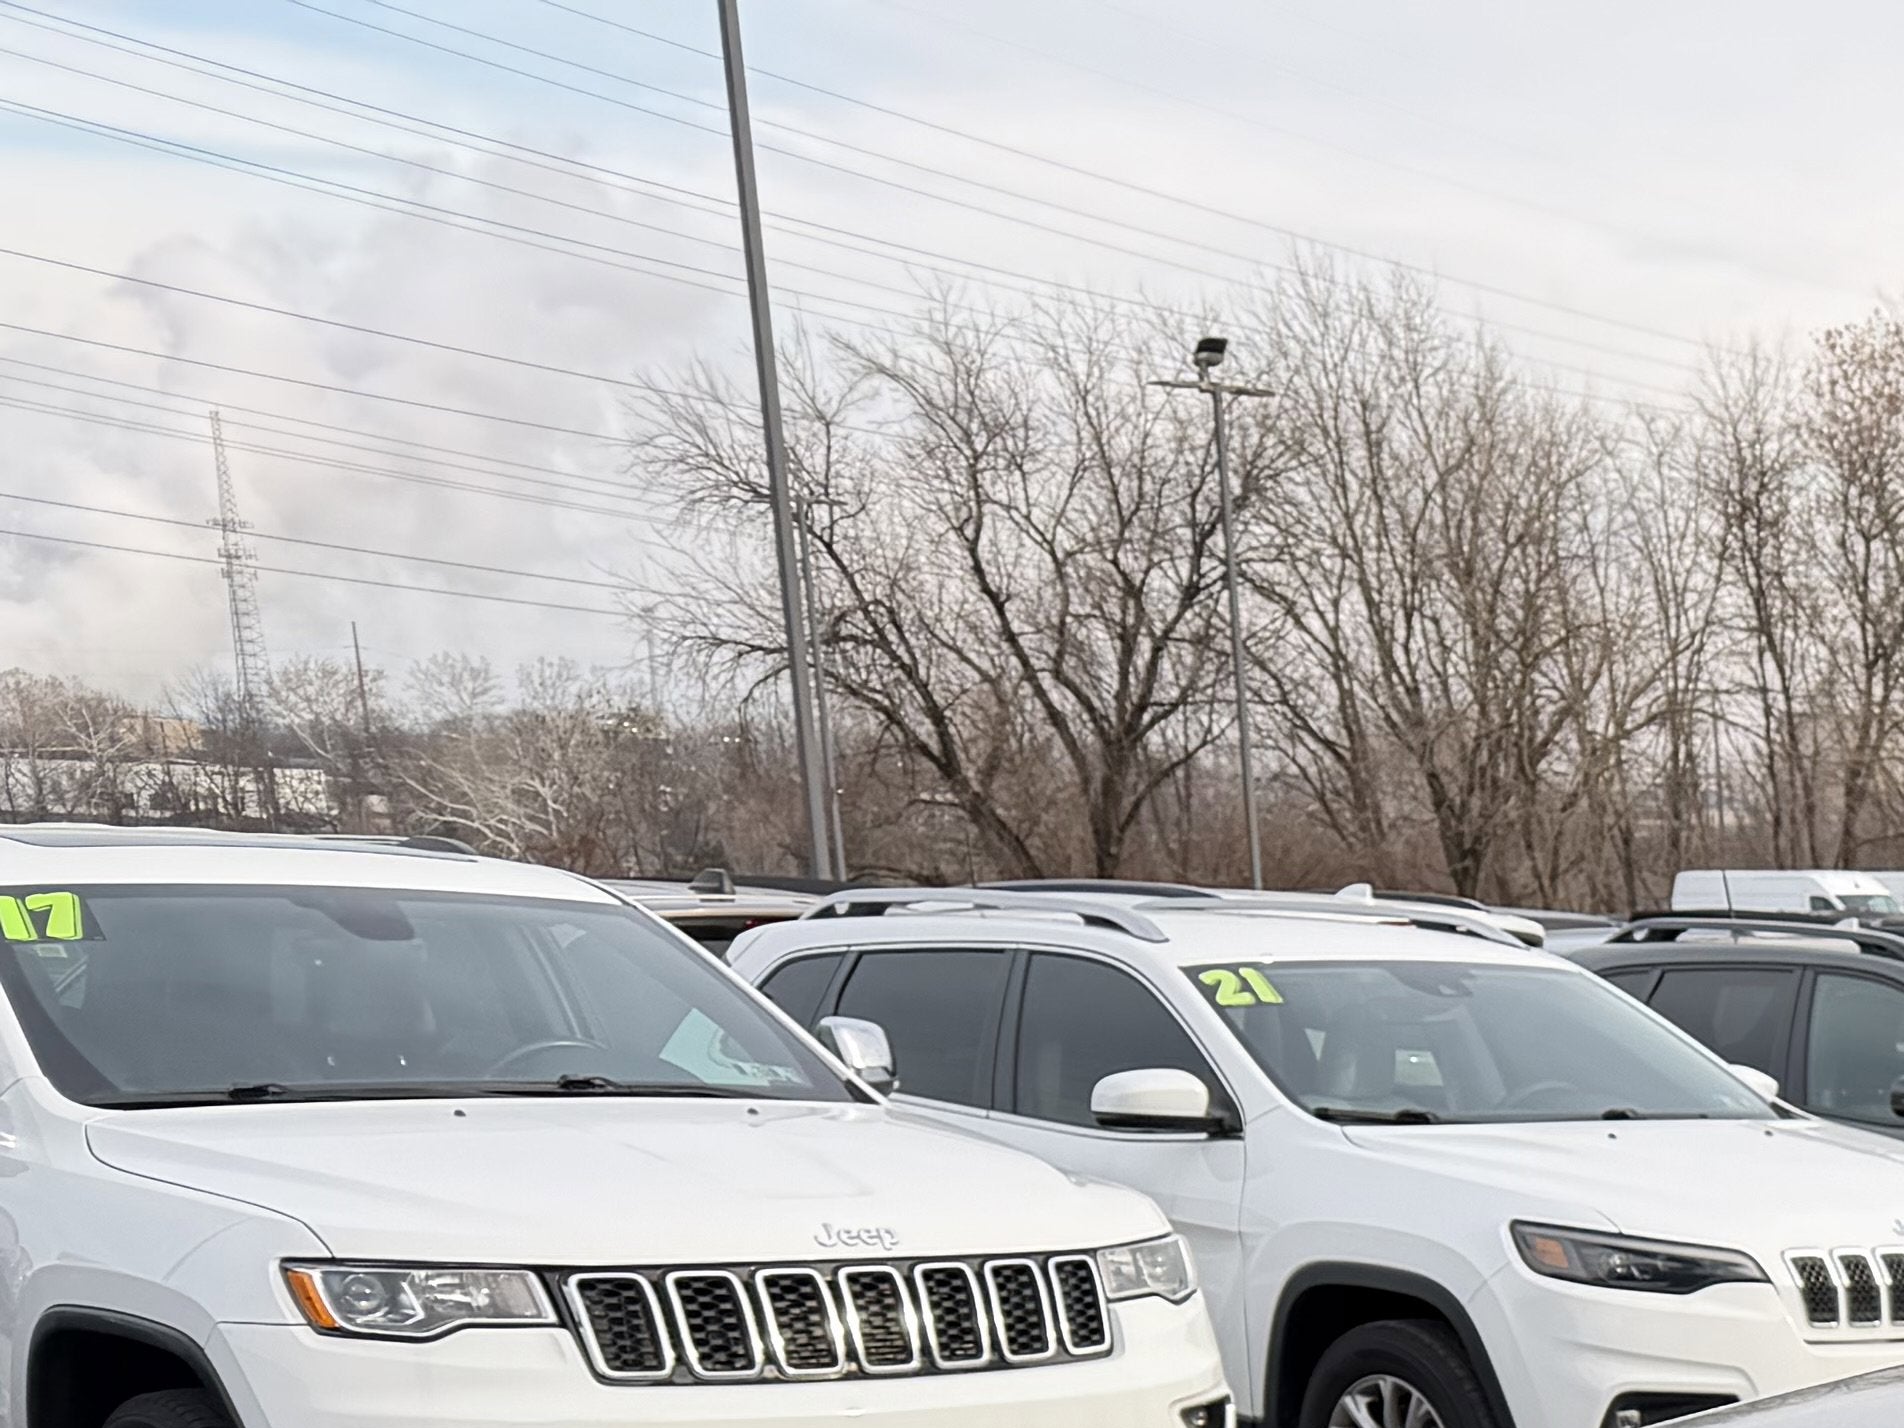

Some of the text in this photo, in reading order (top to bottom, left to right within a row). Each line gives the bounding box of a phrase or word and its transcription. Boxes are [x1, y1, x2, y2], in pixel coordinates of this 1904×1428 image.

[0, 891, 83, 941] 17
[1198, 967, 1284, 1006] 21
[814, 1222, 900, 1251] Jeep
